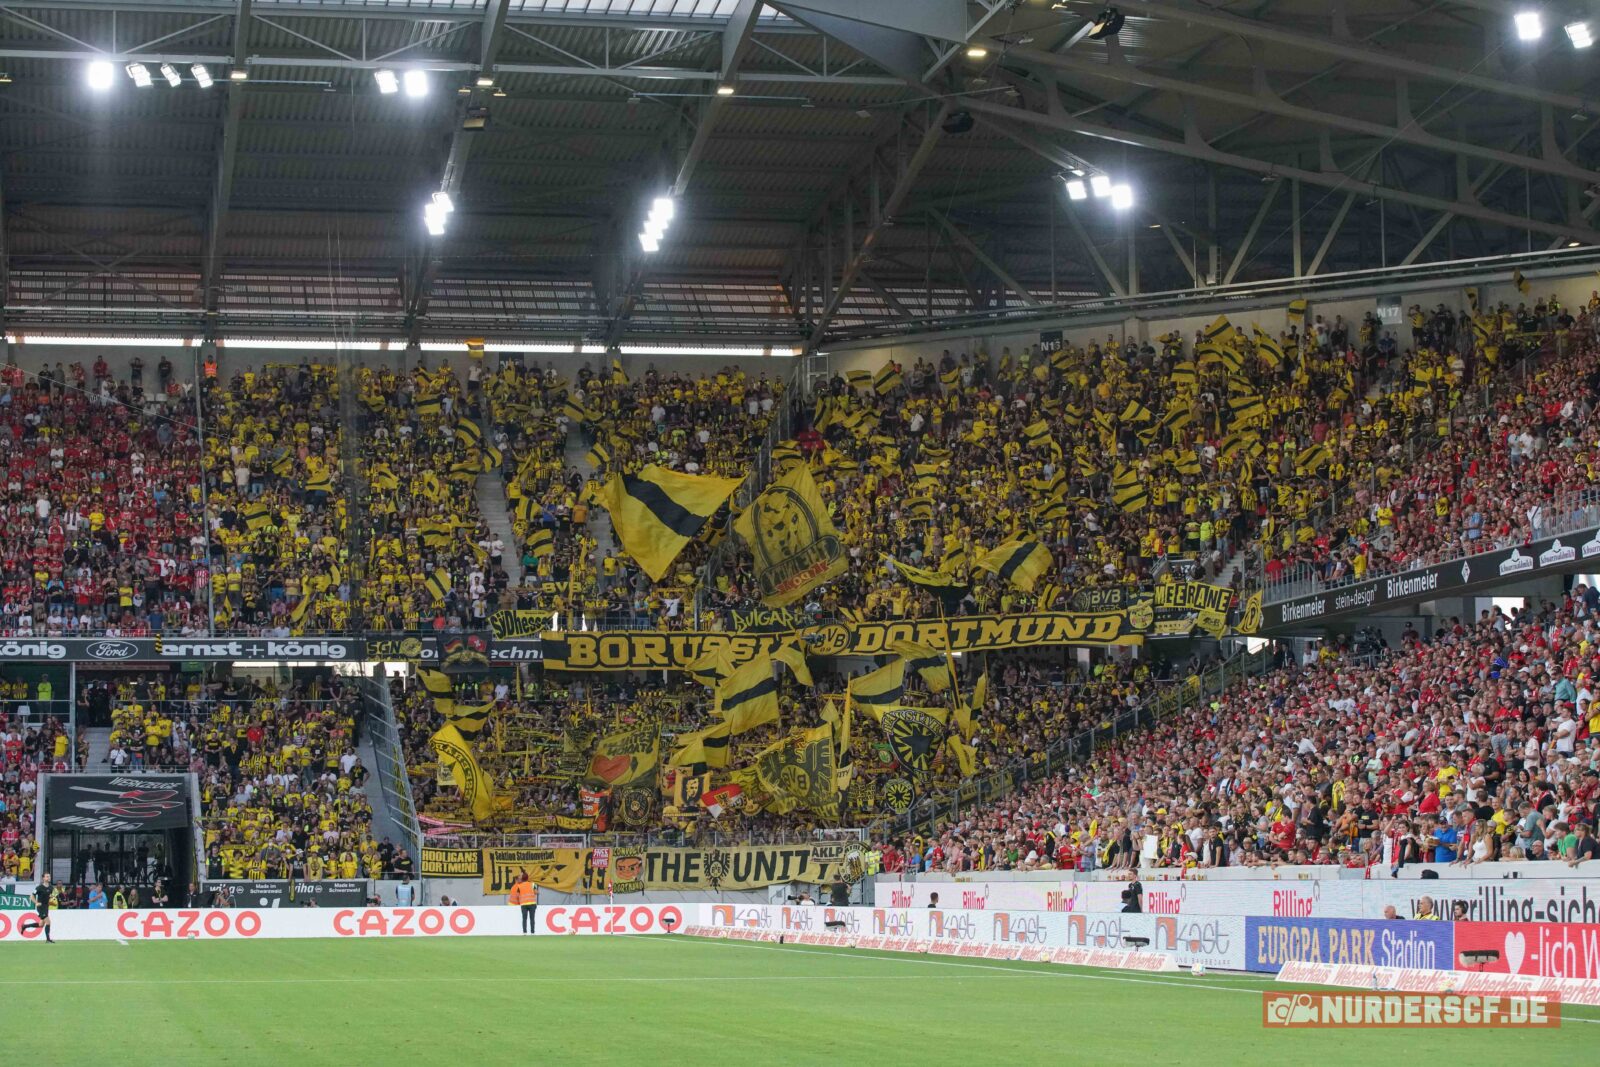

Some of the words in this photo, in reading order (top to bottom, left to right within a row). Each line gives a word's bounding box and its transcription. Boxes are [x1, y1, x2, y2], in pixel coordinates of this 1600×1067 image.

[1377, 306, 1399, 318] N17
[1387, 570, 1439, 599] Birkenmeier
[1155, 583, 1234, 614] MEERANE
[1282, 597, 1325, 623] Birkenmeier
[851, 612, 1123, 653] DORTMUND
[0, 641, 66, 659] önig
[96, 642, 128, 657] Ford
[162, 641, 243, 656] ernst
[246, 644, 265, 656] +
[267, 641, 347, 659] könig
[422, 850, 478, 862] HOOLIGANS
[811, 846, 843, 858] AKLP
[421, 862, 478, 874] DORTMUND
[646, 851, 700, 884] THE
[962, 891, 985, 910] Rilling
[1047, 892, 1073, 912] Rilling
[1149, 892, 1180, 914] Rilling
[1273, 890, 1313, 917] Rilling
[117, 911, 262, 938] CAZOO
[333, 906, 476, 937] CAZOO
[546, 905, 683, 935] CAZOO
[1258, 925, 1322, 966] EUROPA
[1328, 927, 1376, 966] PARK
[1380, 928, 1436, 970] Stadion
